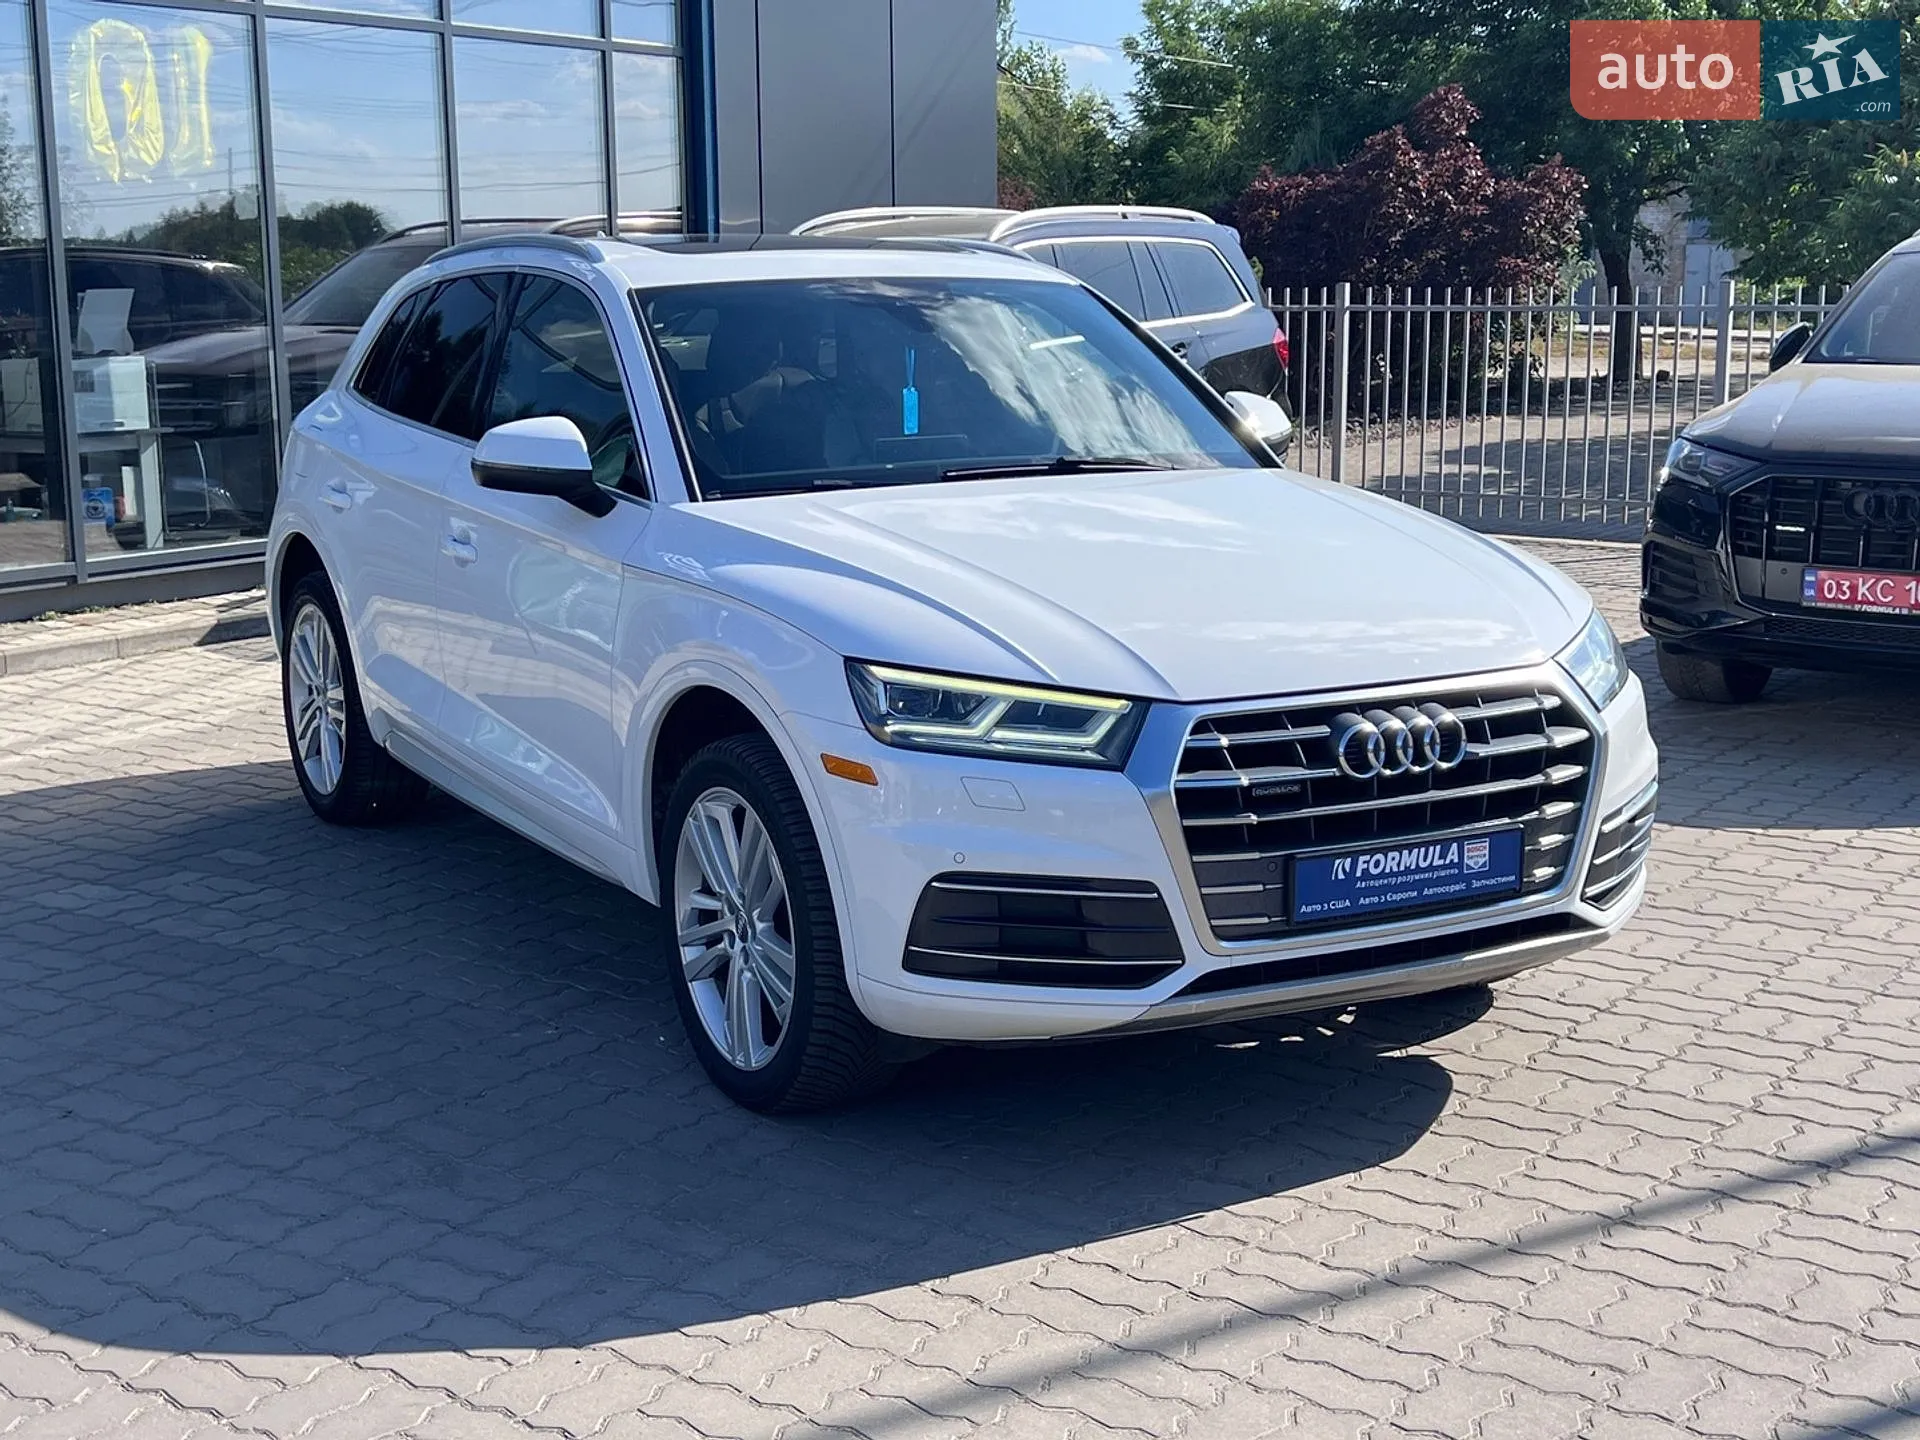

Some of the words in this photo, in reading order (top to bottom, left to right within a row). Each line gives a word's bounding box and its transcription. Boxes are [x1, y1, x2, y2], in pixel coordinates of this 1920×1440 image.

[1804, 588, 1815, 596] UA
[1823, 579, 1851, 600] 03
[1857, 577, 1895, 603] KC
[1905, 580, 1920, 605] 1
[1861, 604, 1900, 614] FORMULA
[1355, 843, 1459, 878] FORMULA
[1355, 876, 1397, 889] Автоцентр
[1471, 875, 1516, 888] Запчастини
[1423, 882, 1467, 896] Автосервіс
[1300, 904, 1321, 913] Авто
[1329, 899, 1351, 909] США
[1359, 896, 1379, 905] Авто
